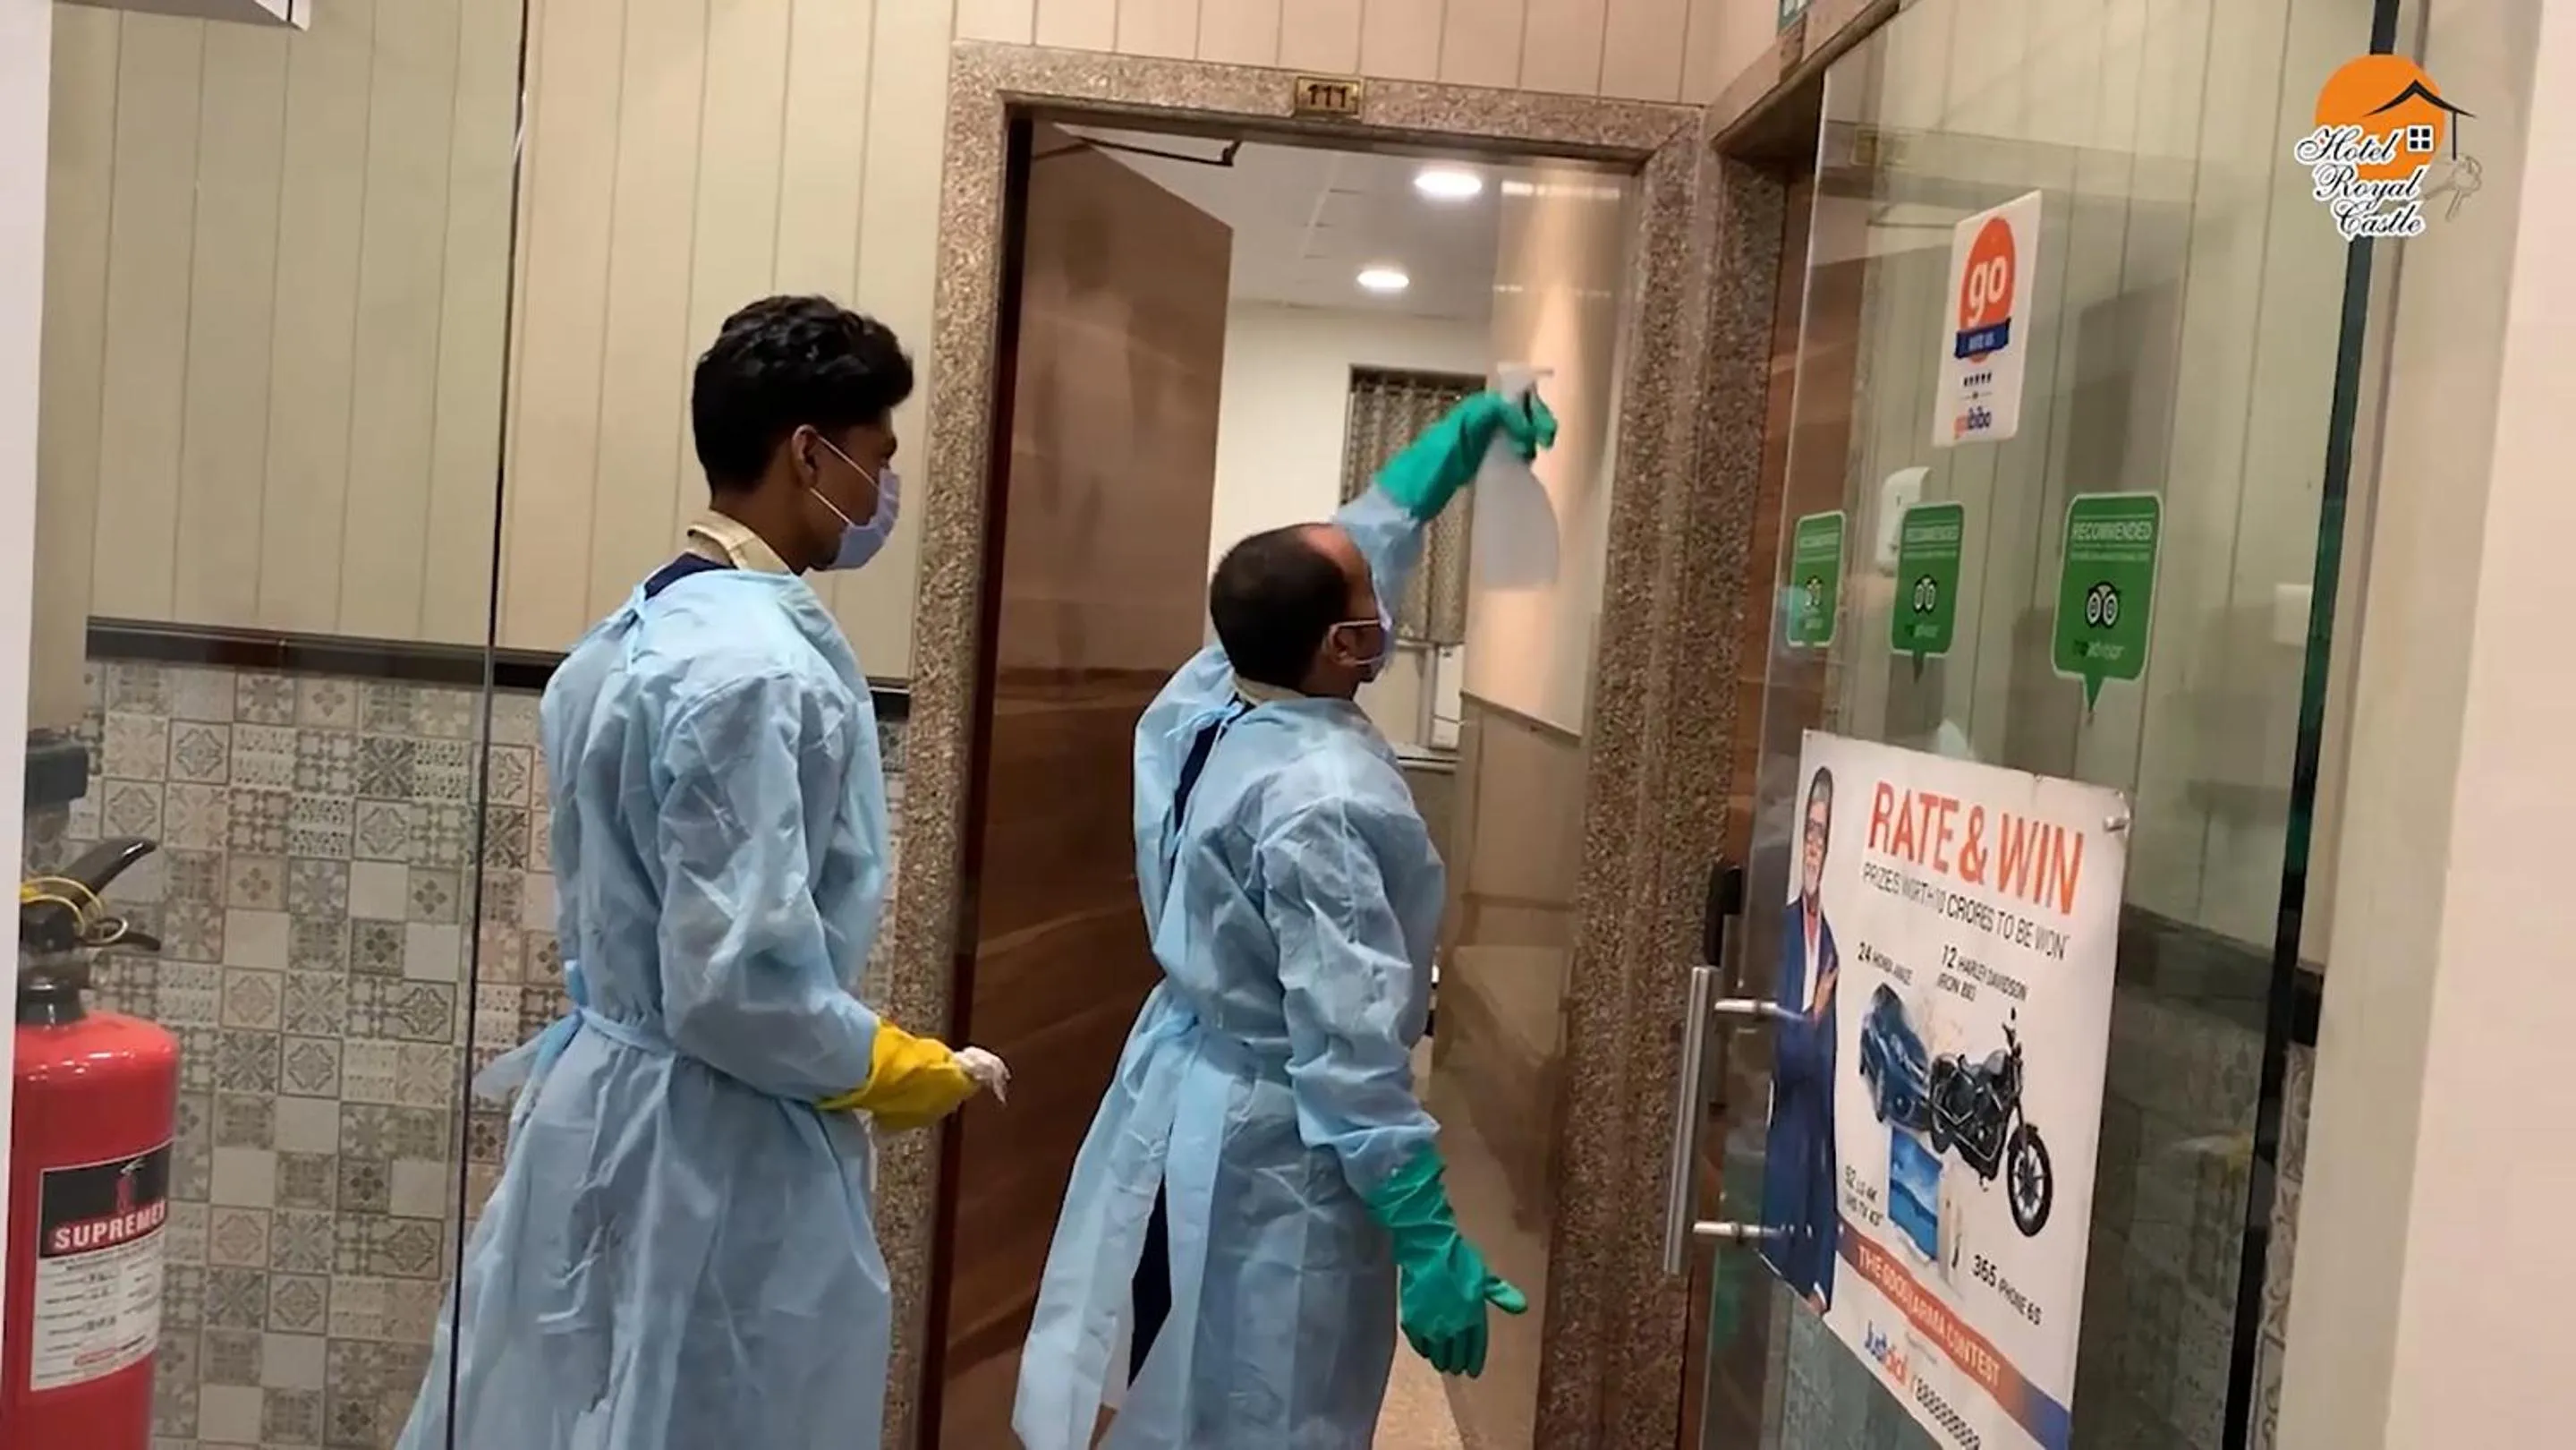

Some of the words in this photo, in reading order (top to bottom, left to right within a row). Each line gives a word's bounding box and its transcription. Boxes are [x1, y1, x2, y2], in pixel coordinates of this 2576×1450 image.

[1307, 83, 1349, 108] 111
[1968, 255, 2007, 328] go
[2072, 521, 2152, 541] RECOMMENDED
[1868, 780, 1960, 874] RATE
[1958, 806, 1988, 885] &
[1997, 813, 2085, 916] WIN
[1863, 862, 1901, 894] PRIZES
[1947, 894, 1995, 932] CRORES
[1996, 910, 2013, 939] TO
[2015, 918, 2035, 948] BE
[1858, 941, 1873, 962] 24
[1941, 944, 1957, 968] 12
[1971, 1254, 1996, 1287] 365
[1858, 1244, 1883, 1278] THE
[1946, 1321, 2001, 1386] CONTEST
